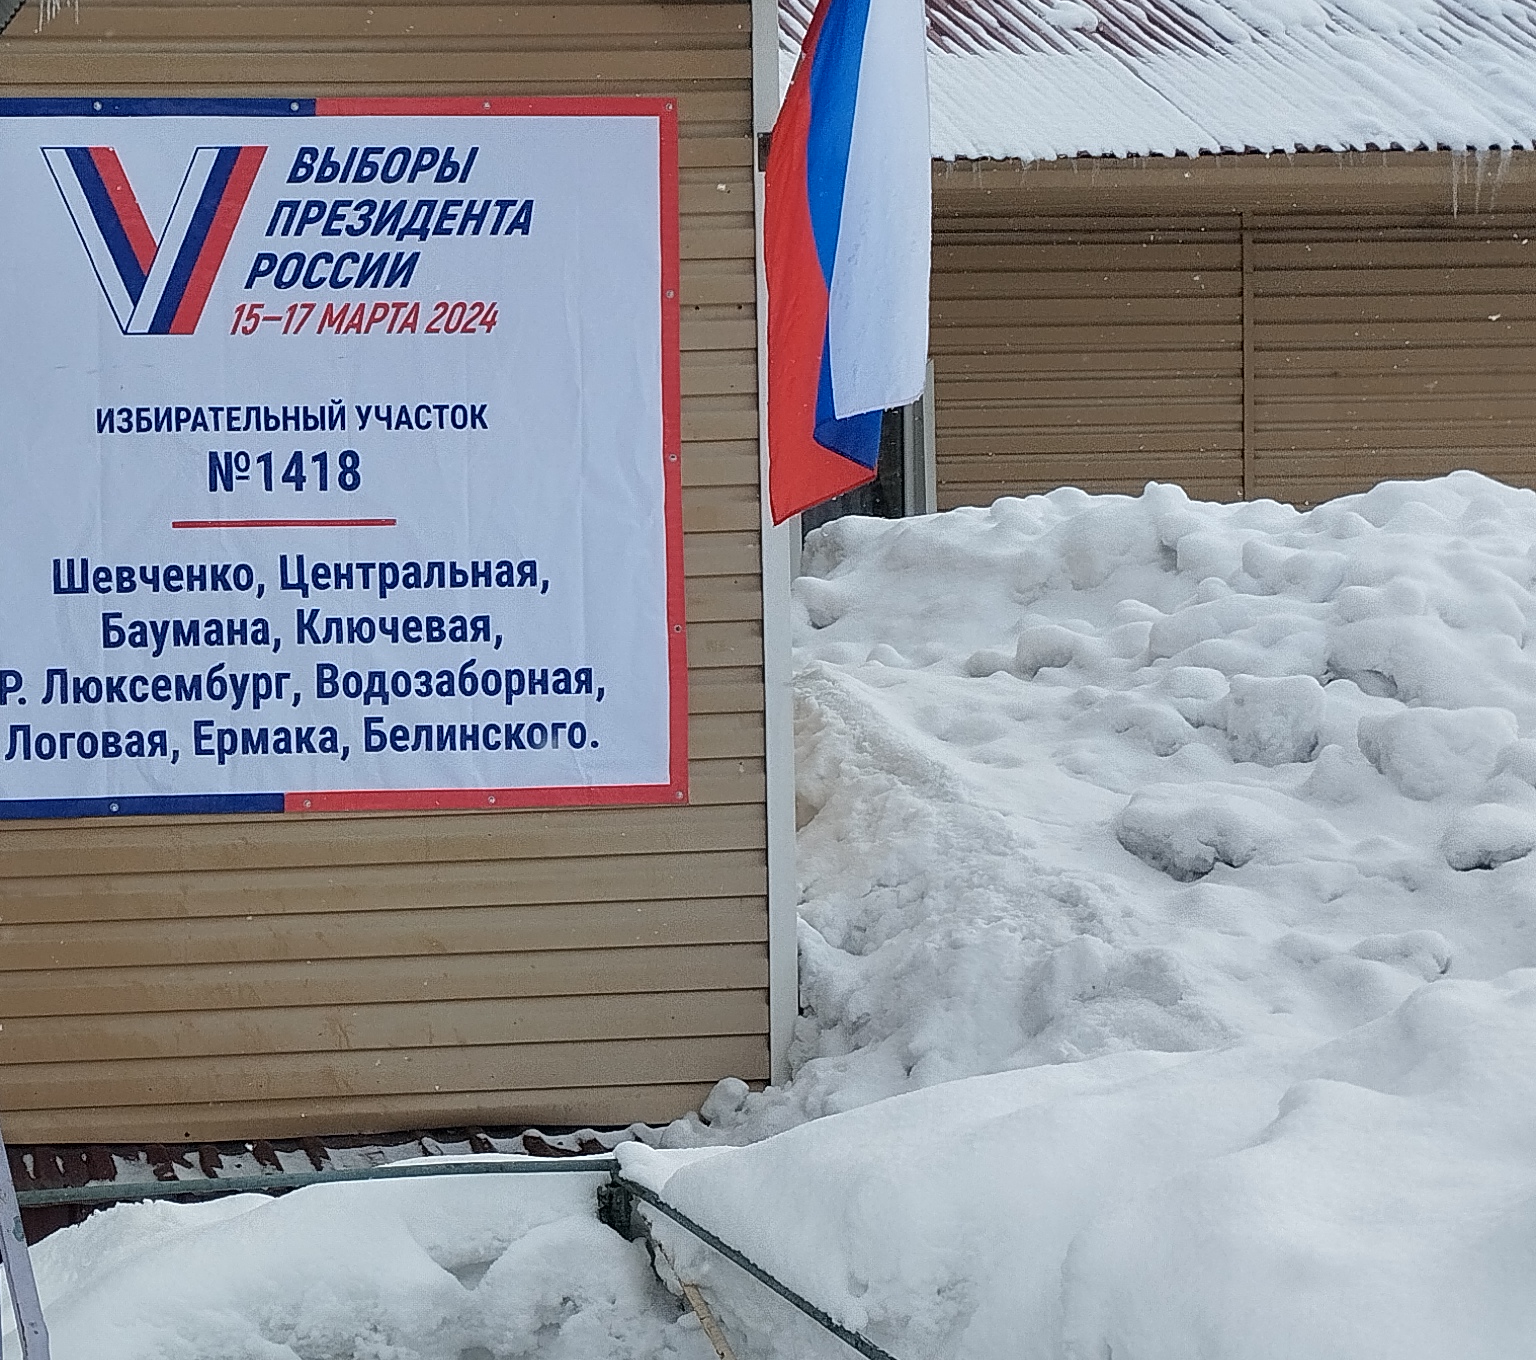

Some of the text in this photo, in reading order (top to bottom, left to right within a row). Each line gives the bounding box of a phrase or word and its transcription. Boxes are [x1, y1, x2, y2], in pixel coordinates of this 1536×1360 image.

[286, 146, 478, 184] ВЫБОРЫ
[265, 199, 535, 241] ПРЕЗИДЕНТА
[244, 251, 420, 290] РОССИИ
[316, 302, 421, 335] МАРТА
[425, 302, 499, 334] 2024
[96, 399, 488, 434] ИЗБИРАТЕЛЬНЫЙ УЧАСТОК
[208, 450, 362, 493] №1418
[53, 554, 550, 598] Шевченко, Центральная,
[101, 609, 503, 655] Баумана, Ключевая,
[0, 661, 607, 710] Р. Люксембург, Водозаборная,
[5, 716, 599, 765] Логовая, Ермака, Белинского.
